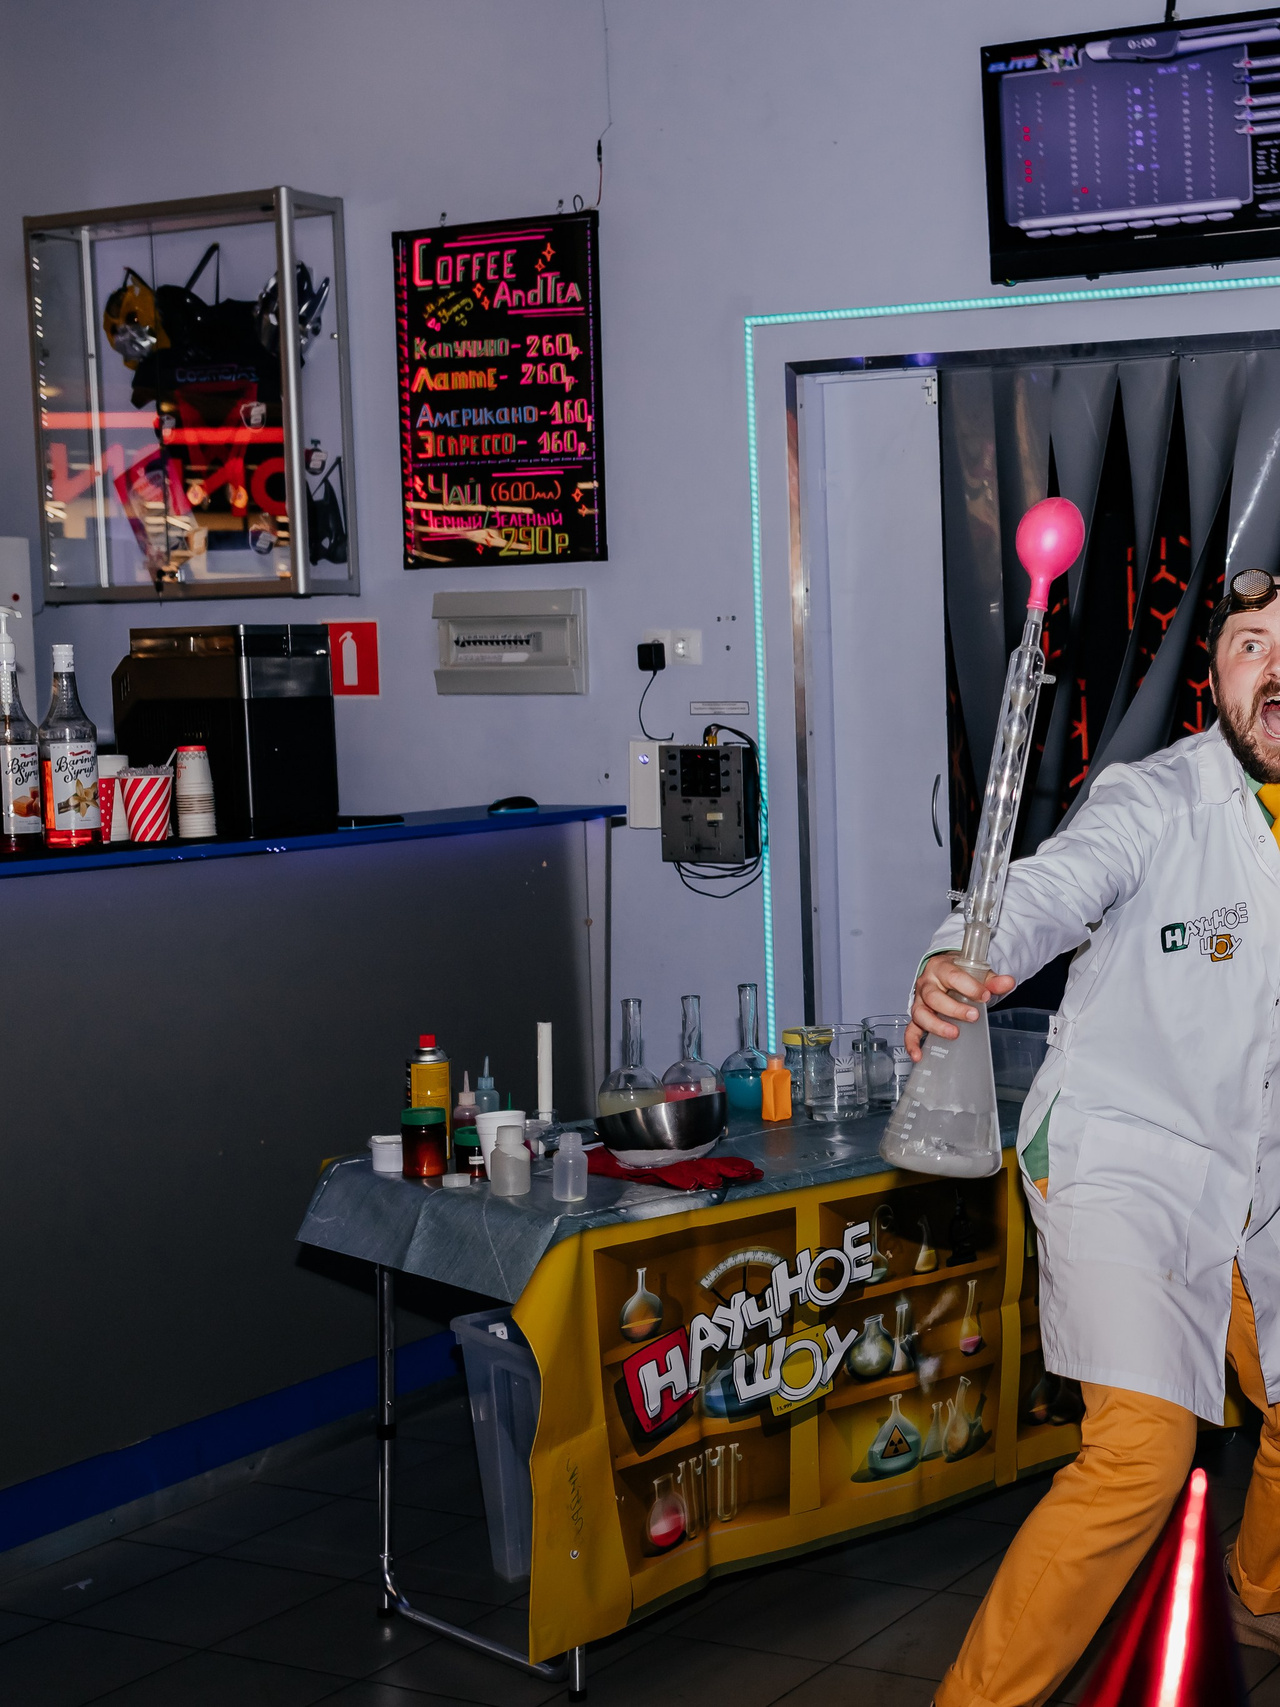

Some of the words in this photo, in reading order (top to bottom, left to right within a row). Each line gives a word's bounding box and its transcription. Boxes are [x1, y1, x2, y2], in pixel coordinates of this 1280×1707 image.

[1164, 902, 1248, 949] НАУЧНОЕ
[1200, 934, 1242, 958] ШОУ
[637, 1220, 874, 1420] НАУЧНОЕ
[732, 1325, 859, 1404] ШОУ
